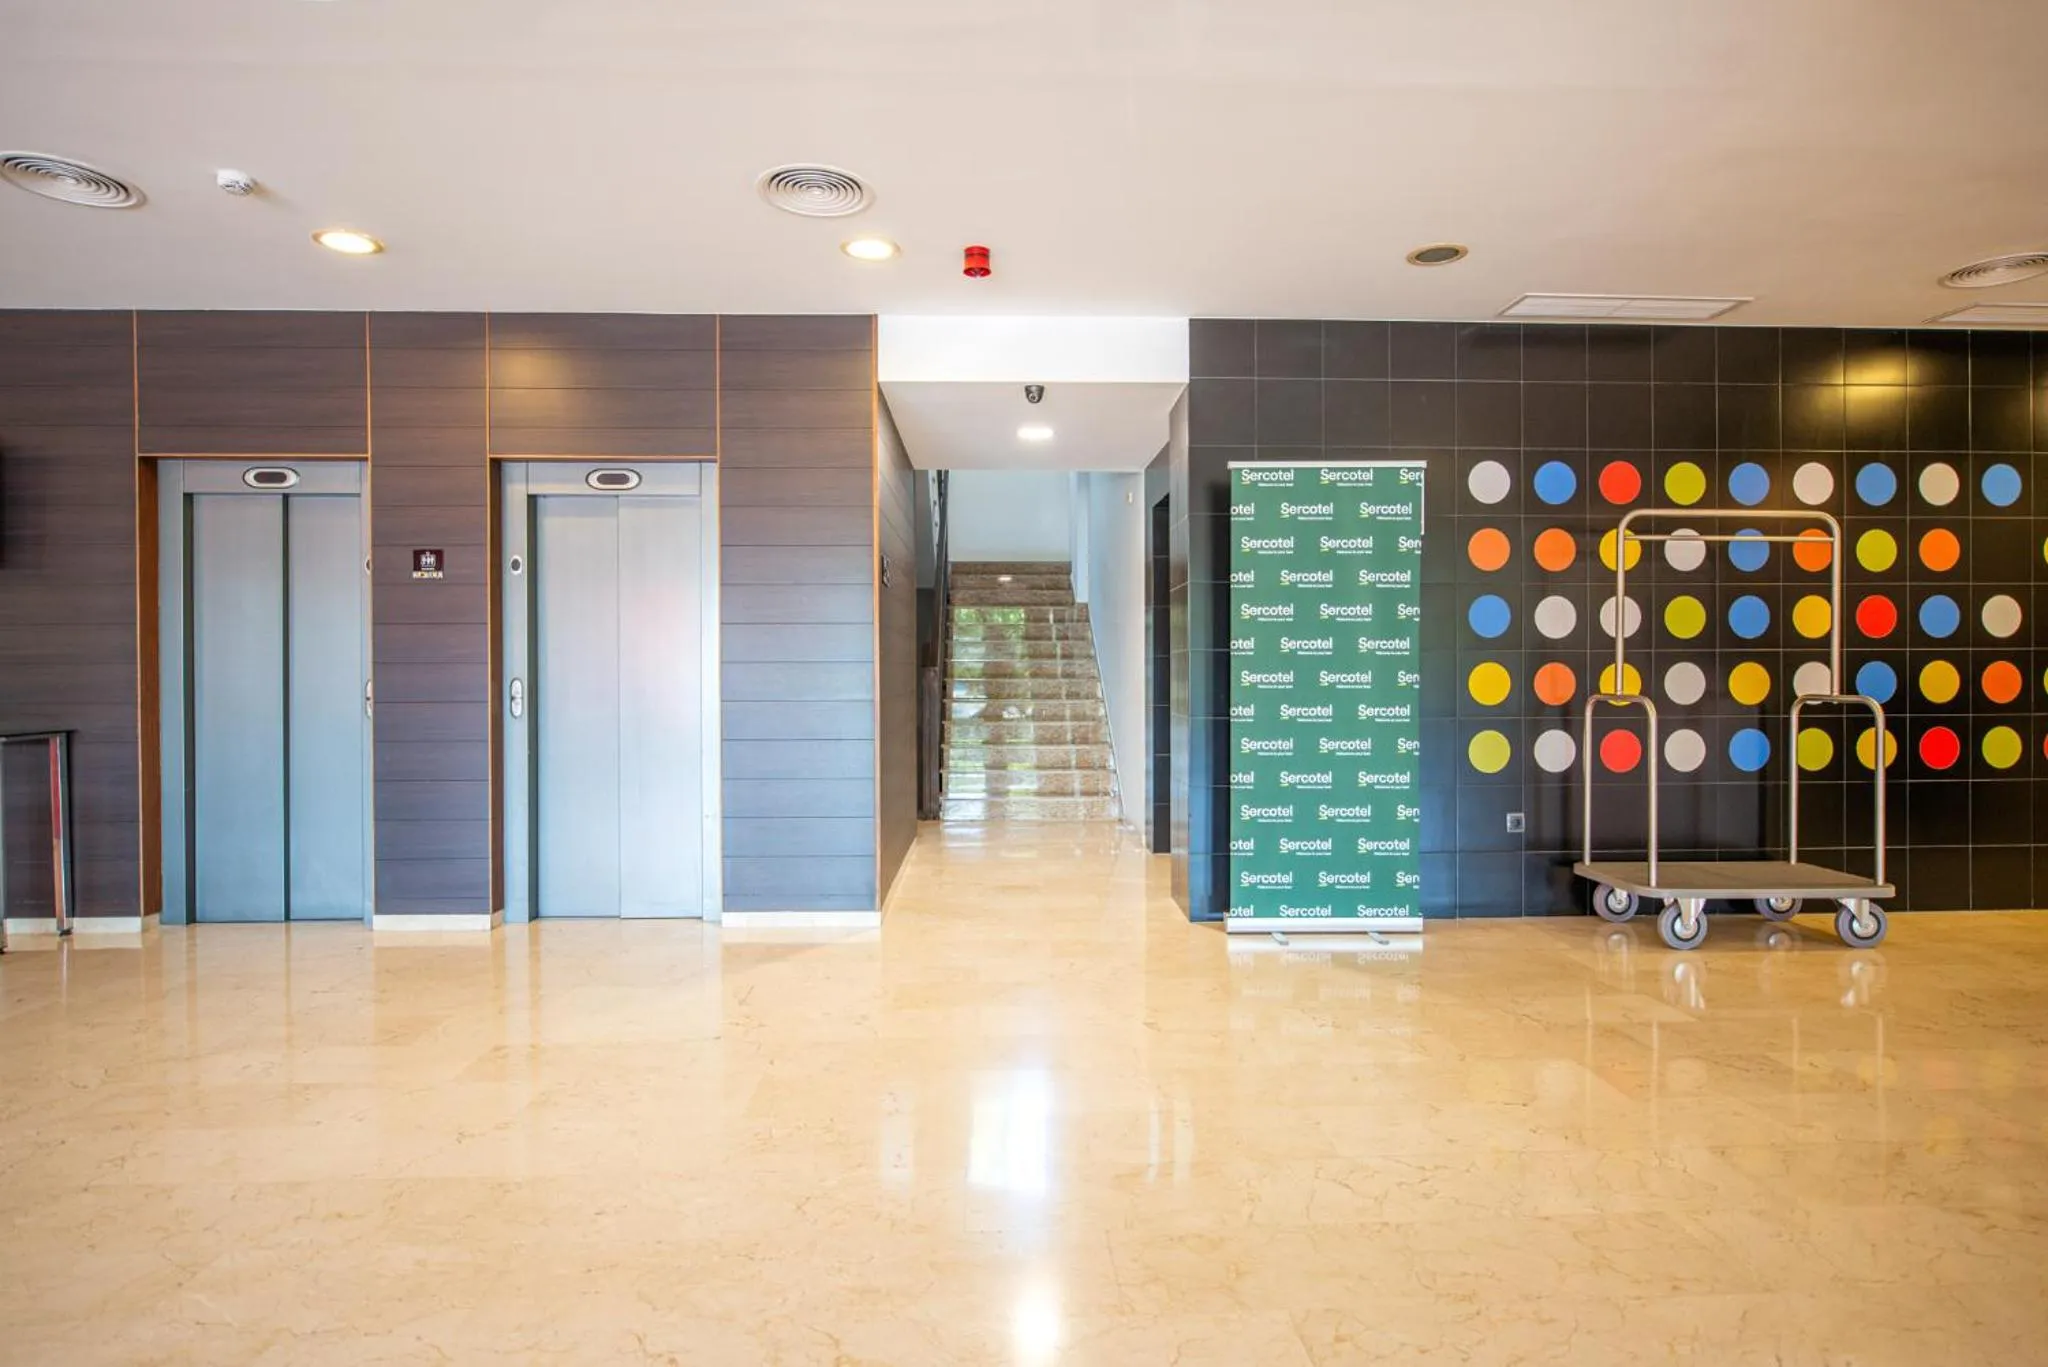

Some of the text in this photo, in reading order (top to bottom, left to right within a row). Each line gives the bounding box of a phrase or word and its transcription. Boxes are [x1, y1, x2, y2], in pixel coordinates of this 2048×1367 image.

[1241, 468, 1293, 481] Sercotel
[1320, 468, 1373, 481] Sercotel
[1230, 502, 1254, 515] otel
[1280, 502, 1333, 515] Sercotel
[1359, 502, 1412, 515] Sercotel
[1240, 536, 1293, 549] Sercotel
[1320, 536, 1372, 549] Sercotel
[1230, 569, 1254, 582] otel
[1280, 569, 1332, 582] Sercotel
[1358, 569, 1410, 582] Sercotel
[1240, 603, 1293, 616] Sercotel
[1319, 603, 1372, 616] Sercotel
[1230, 637, 1254, 650] otel
[1280, 637, 1332, 650] Sercotel
[1358, 637, 1409, 650] Sercotel
[1240, 670, 1293, 683] Sercotel
[1319, 670, 1371, 683] Sercotel
[1230, 704, 1254, 717] otel
[1279, 704, 1332, 717] Sercotel
[1358, 704, 1409, 717] Sercotel
[1240, 737, 1293, 750] Sercotel
[1319, 737, 1371, 750] Sercotel
[1230, 771, 1254, 784] otel
[1279, 771, 1331, 784] Sercotel
[1358, 771, 1409, 784] Sercotel
[1240, 804, 1292, 817] Sercotel
[1319, 804, 1370, 817] Sercotel
[1230, 838, 1254, 851] otel
[1279, 838, 1331, 851] Sercotel
[1358, 838, 1409, 851] Sercotel
[1240, 871, 1292, 884] Sercotel
[1318, 871, 1370, 884] Sercotel
[1230, 904, 1254, 917] otel
[1279, 904, 1331, 917] Sercotel
[1357, 904, 1408, 917] Sercotel
